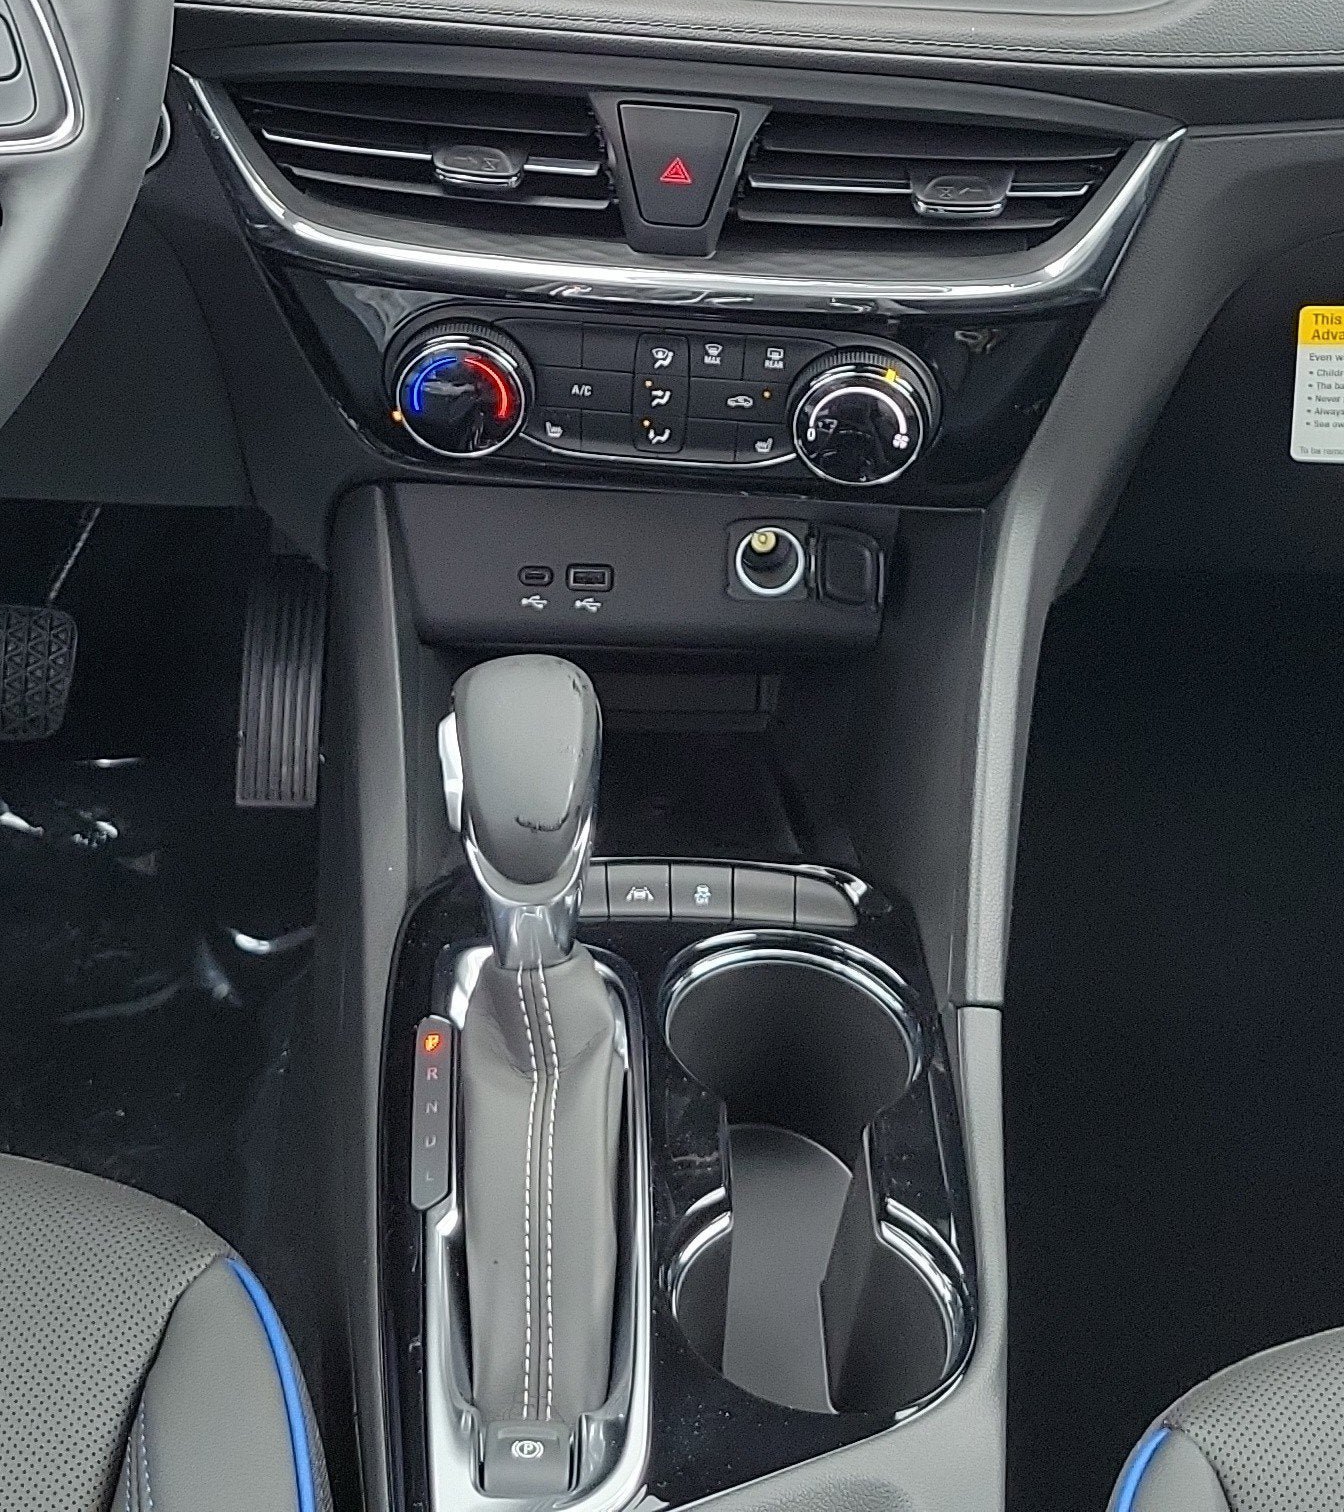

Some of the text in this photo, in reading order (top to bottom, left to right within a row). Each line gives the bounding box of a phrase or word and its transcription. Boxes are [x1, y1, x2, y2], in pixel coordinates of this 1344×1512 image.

[1312, 313, 1342, 326] This
[704, 355, 721, 365] MAX
[1309, 352, 1332, 362] Even
[764, 359, 784, 369] REAR
[571, 385, 592, 397] A/C
[1316, 382, 1332, 390] The
[1315, 395, 1341, 403] Never
[1314, 419, 1330, 428] See
[1299, 446, 1309, 454] To
[425, 1034, 440, 1052] P
[427, 1067, 439, 1080] R
[425, 1099, 438, 1113] N
